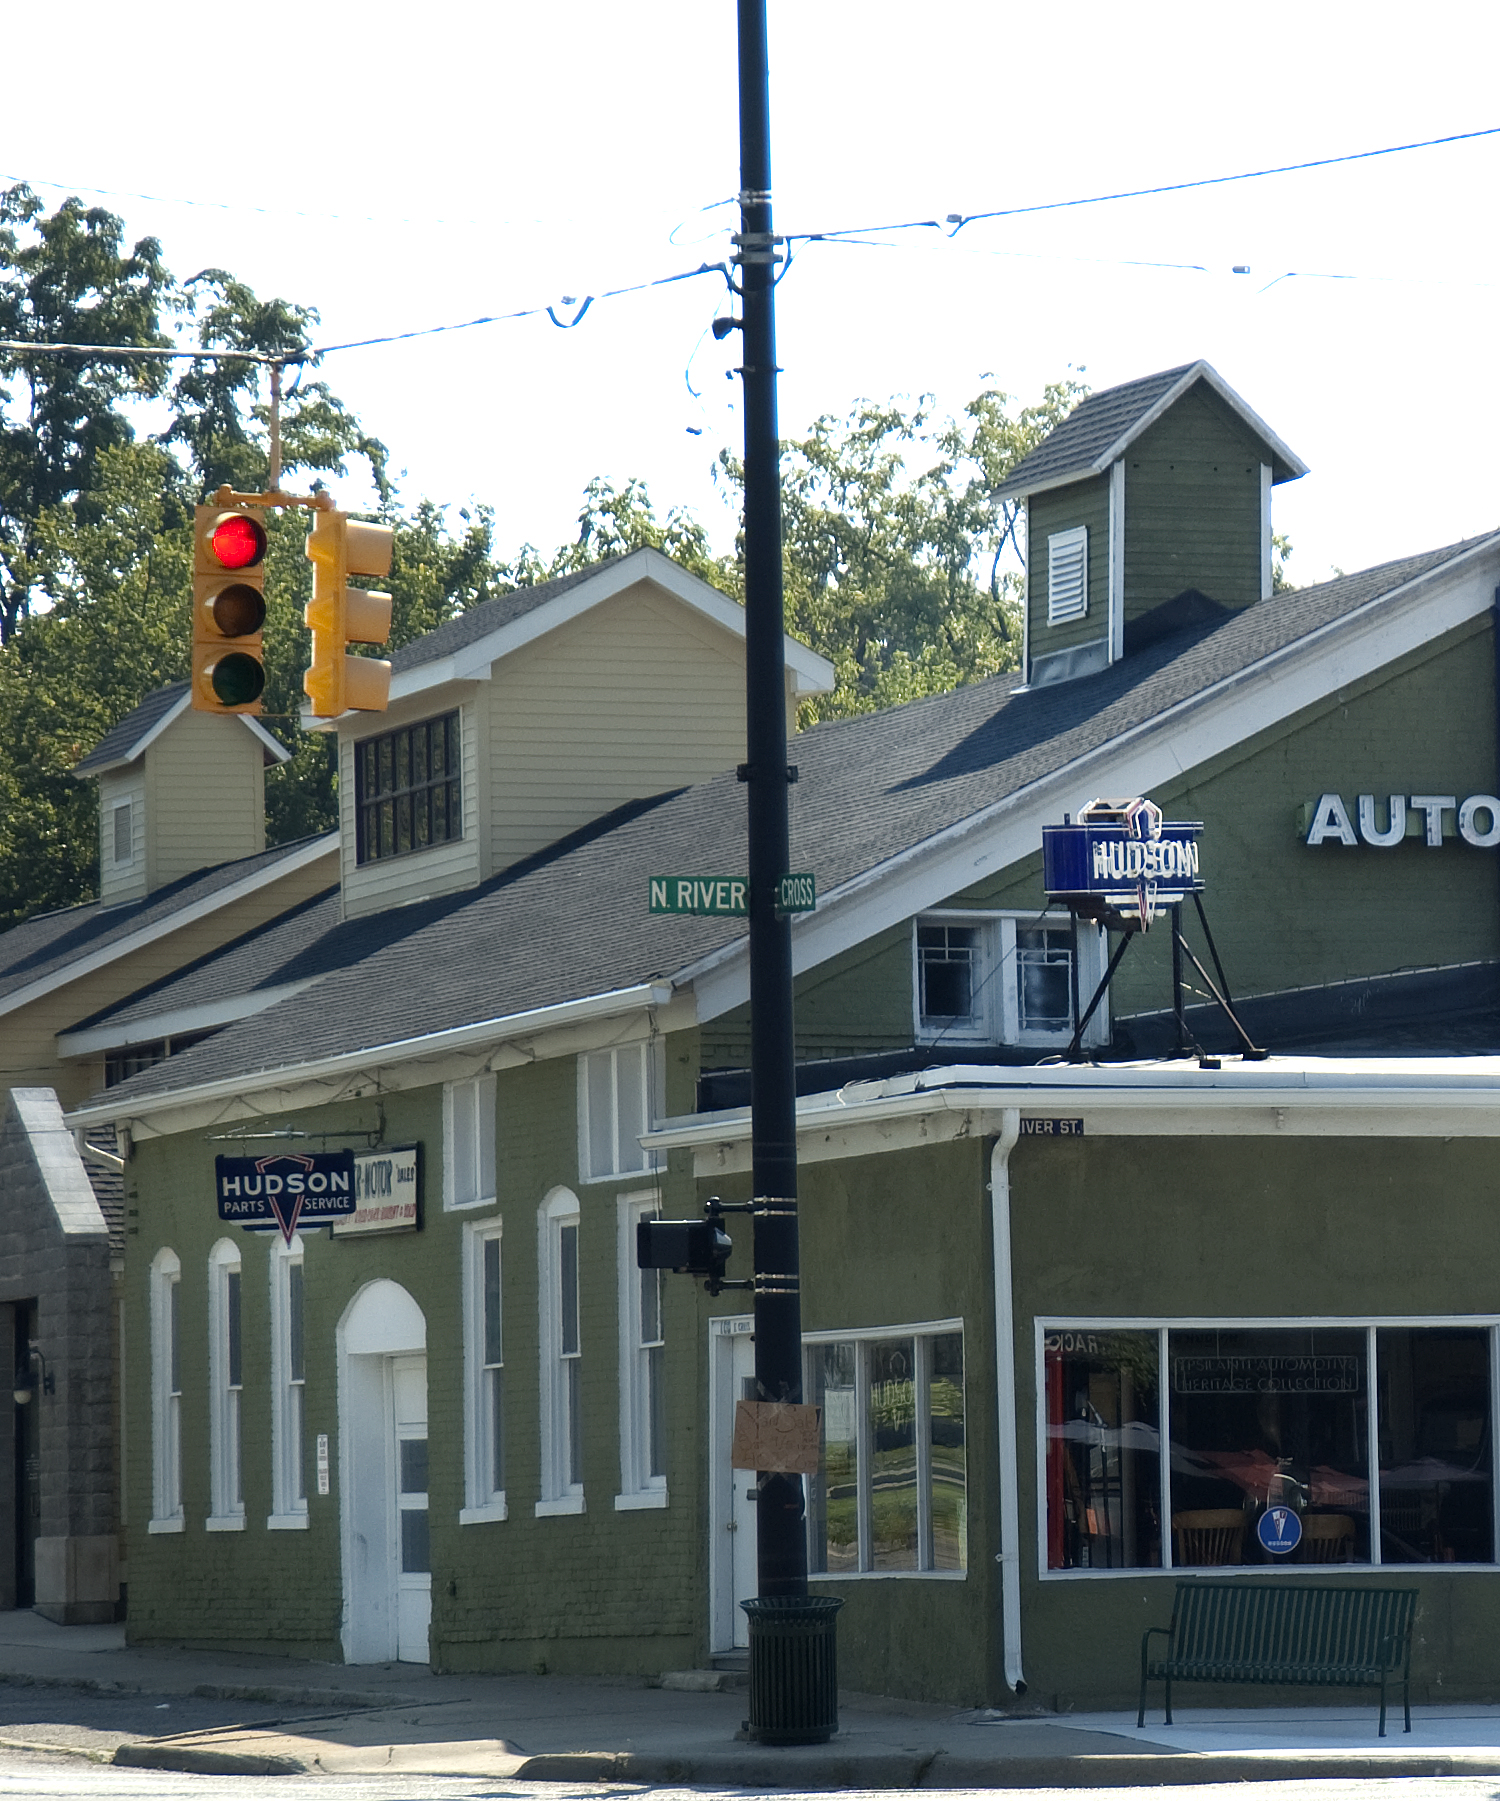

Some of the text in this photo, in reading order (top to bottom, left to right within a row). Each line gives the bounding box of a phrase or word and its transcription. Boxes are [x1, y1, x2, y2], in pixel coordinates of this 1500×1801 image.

[1092, 839, 1199, 880] HUDSON
[651, 880, 746, 909] N. RIVER
[781, 877, 813, 906] CROSS
[1019, 1120, 1081, 1134] IVER ST.
[222, 1171, 350, 1196] HUDSON
[354, 1159, 393, 1200] R-MOTOR
[224, 1196, 350, 1213] PARTS SERVICE
[1178, 1357, 1356, 1371] YPSILANTI AUTOMOTIVE
[1183, 1377, 1352, 1391] HERITAGE COLLECTION
